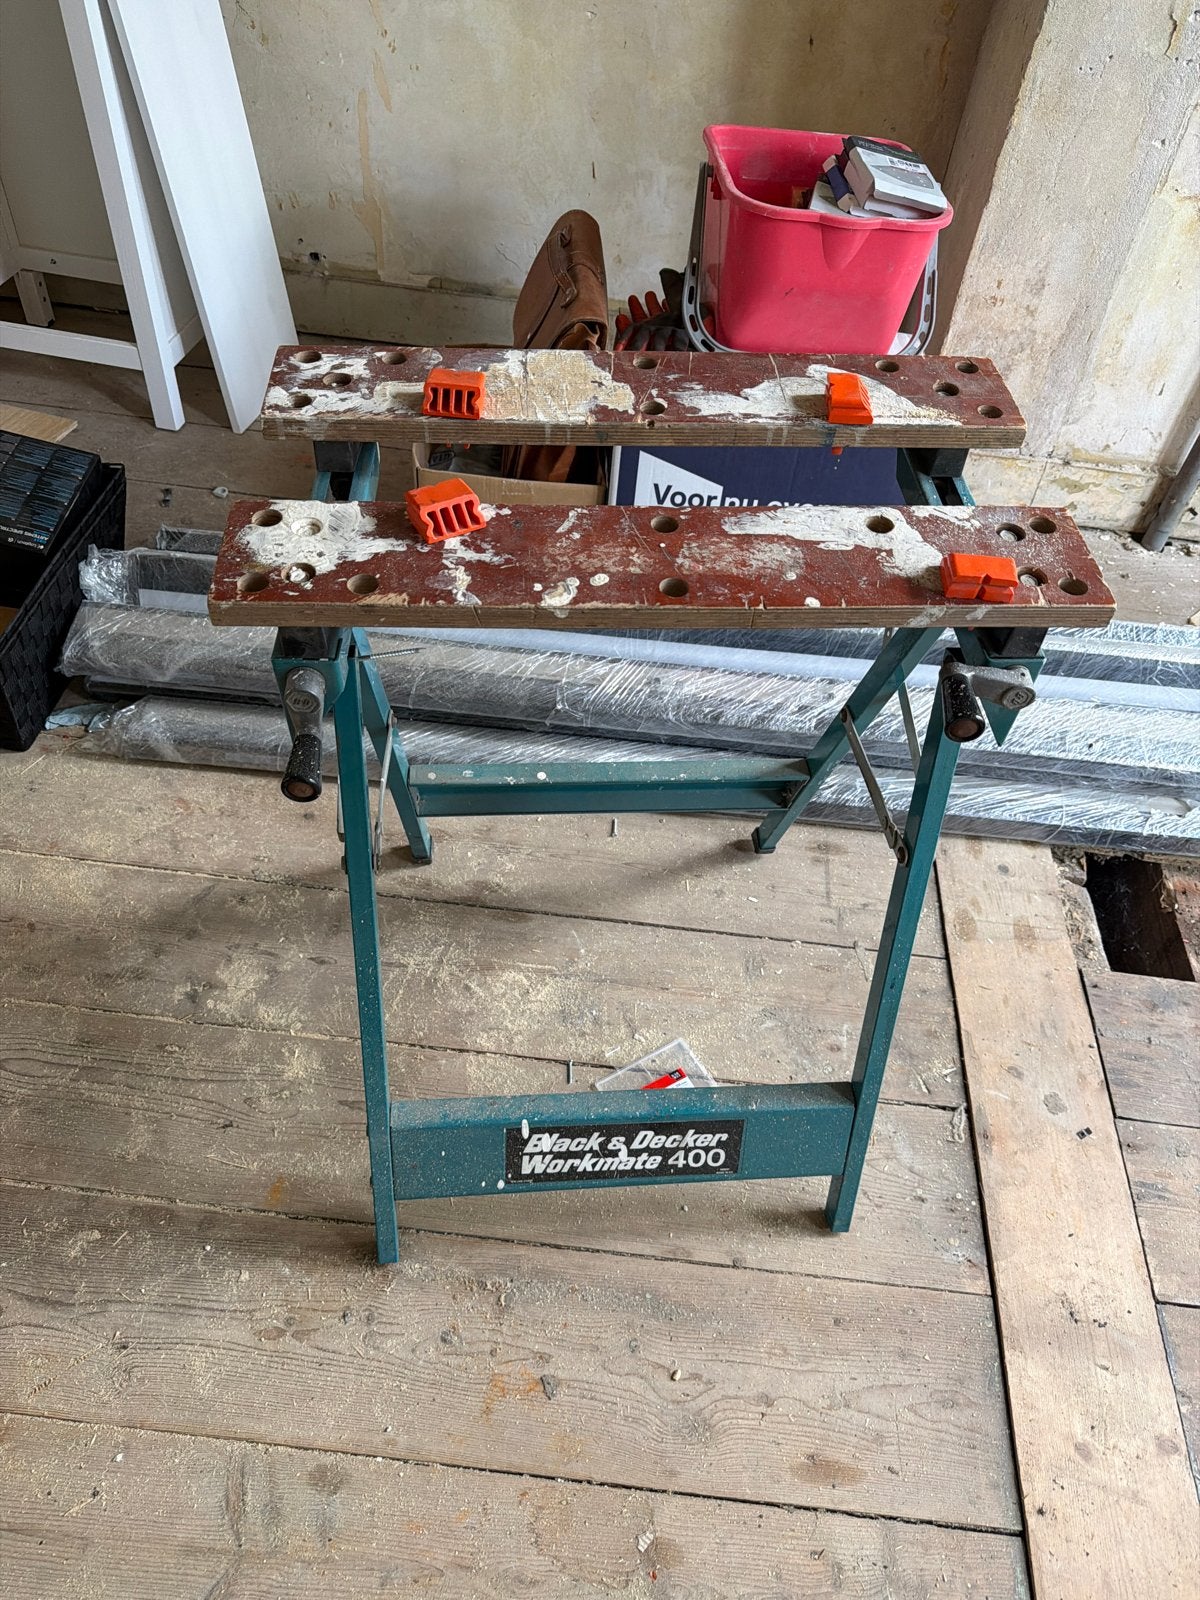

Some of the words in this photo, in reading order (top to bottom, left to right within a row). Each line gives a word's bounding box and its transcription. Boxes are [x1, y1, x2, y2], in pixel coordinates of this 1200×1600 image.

[653, 483, 717, 507] Voor
[523, 1132, 606, 1153] Black
[607, 1136, 627, 1150] &
[630, 1129, 728, 1149] Decker
[521, 1153, 662, 1174] Workmate
[668, 1149, 725, 1167] 400
